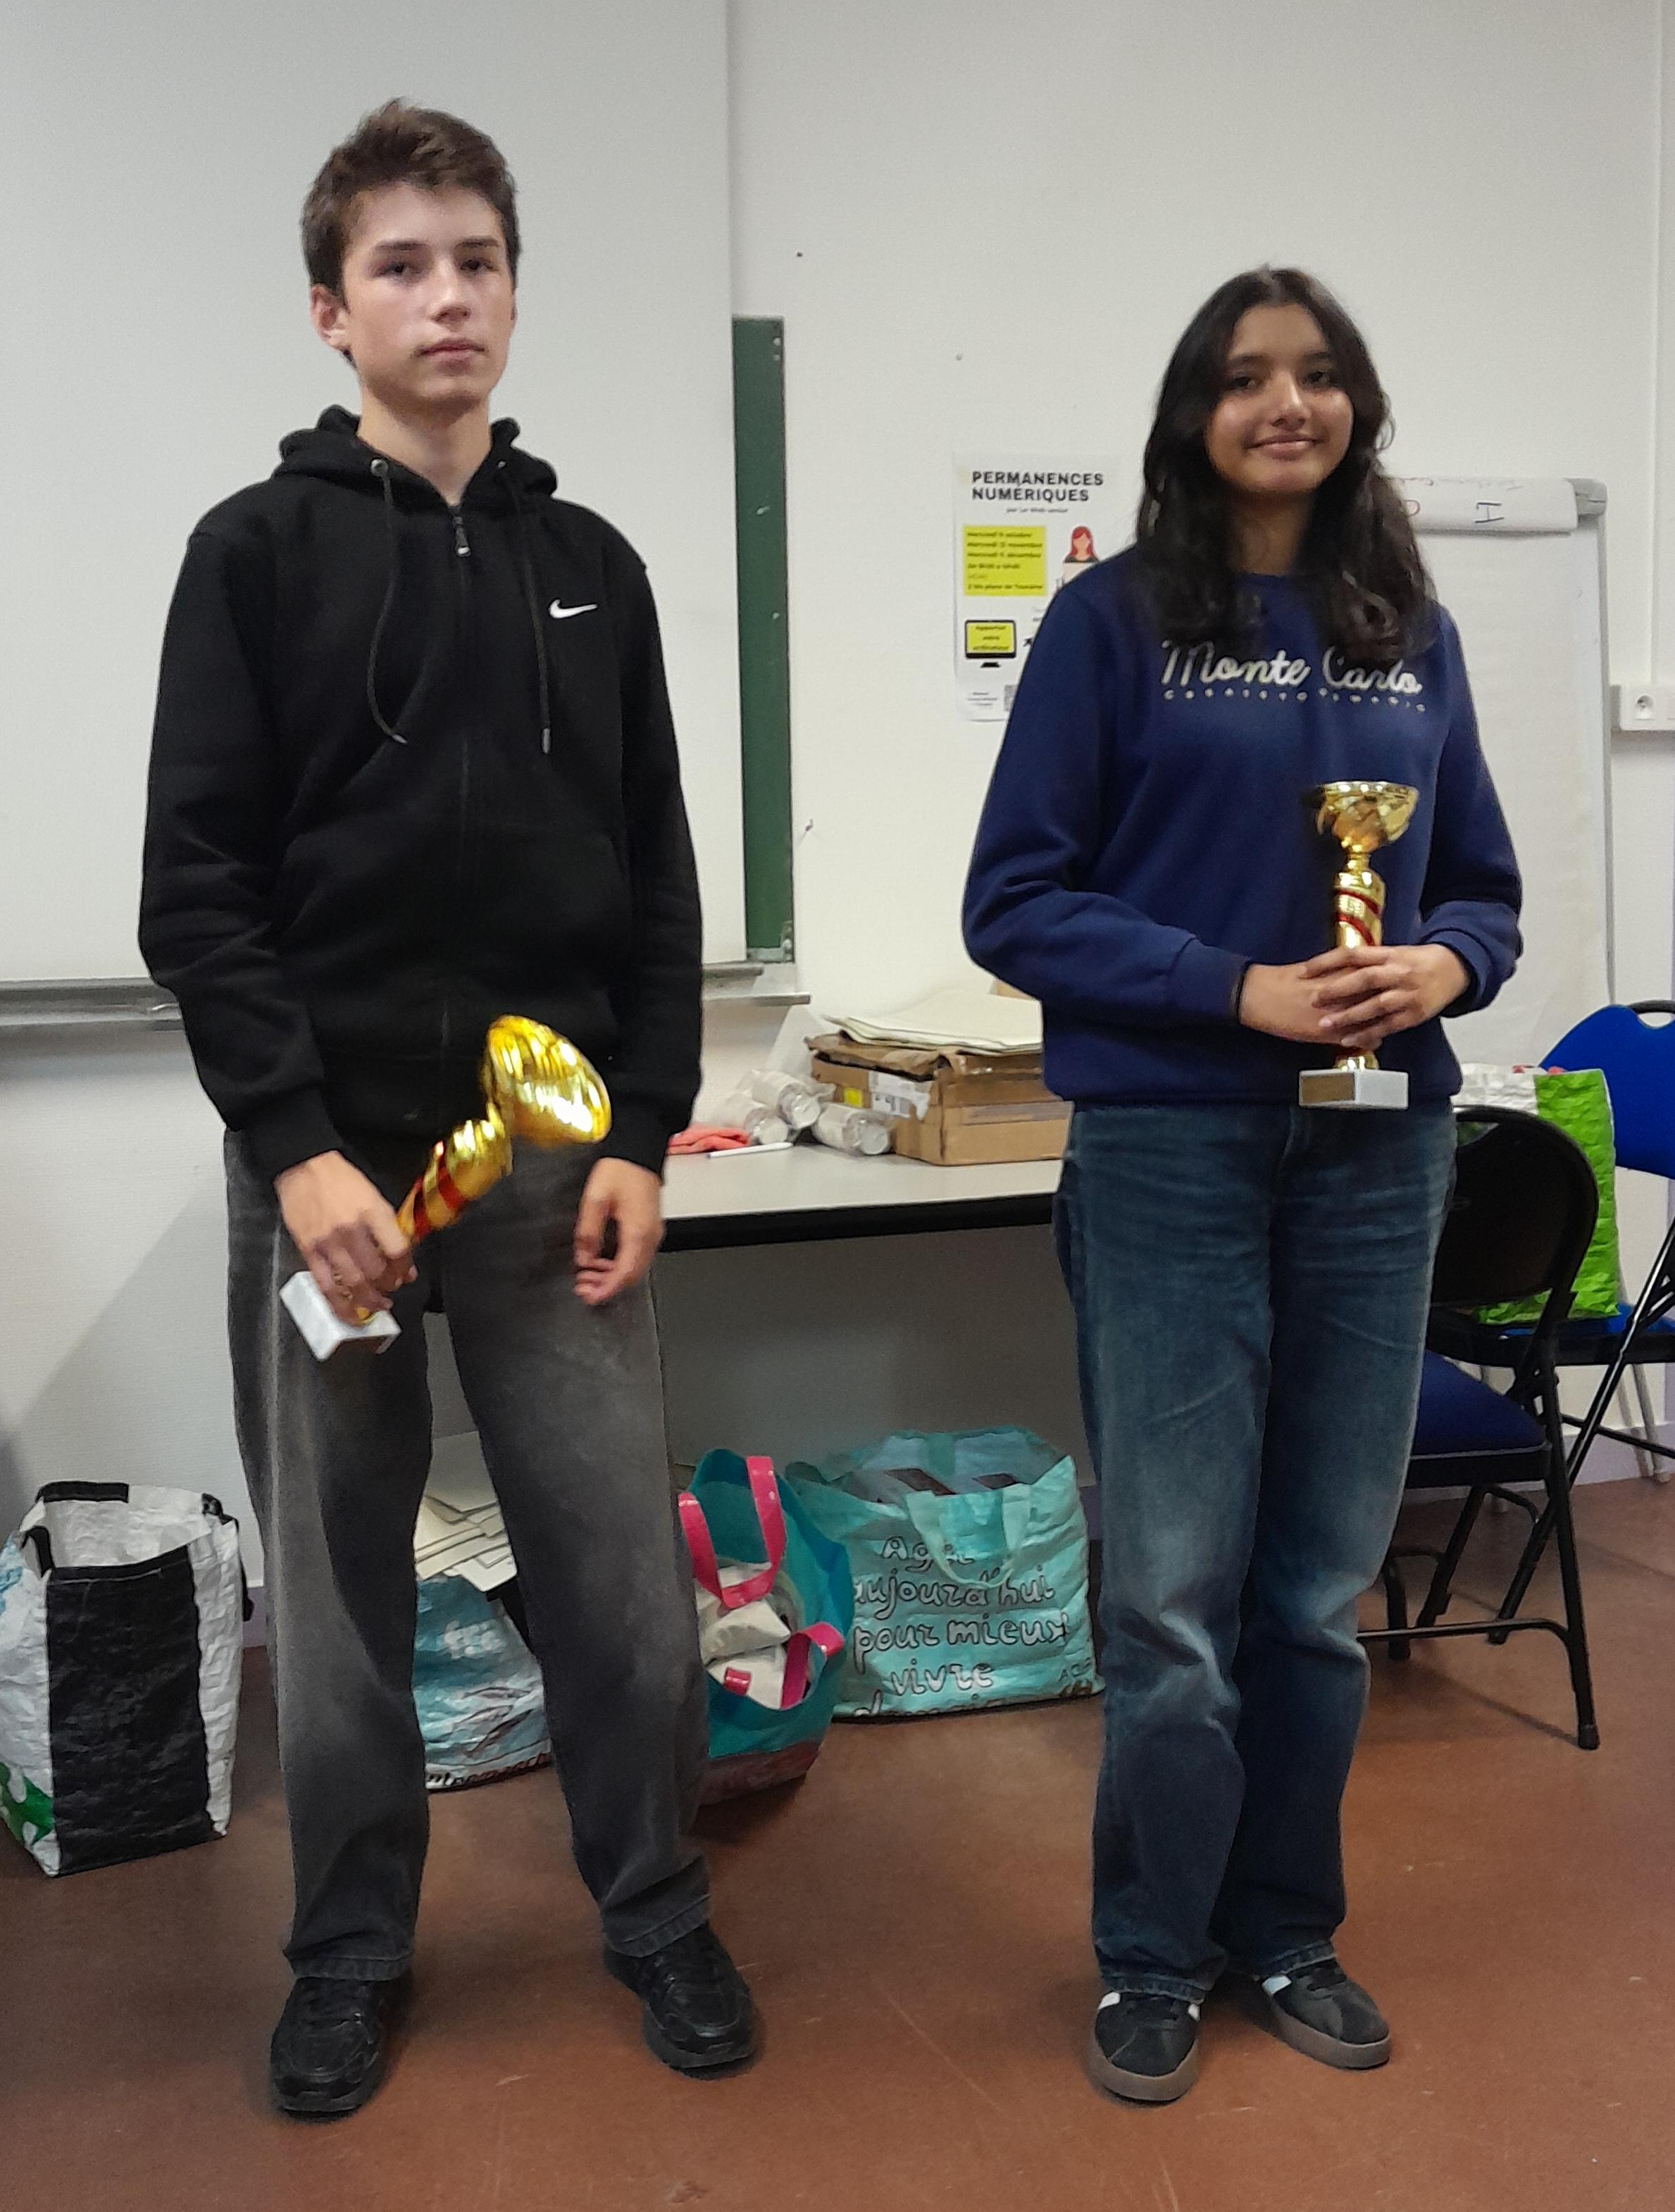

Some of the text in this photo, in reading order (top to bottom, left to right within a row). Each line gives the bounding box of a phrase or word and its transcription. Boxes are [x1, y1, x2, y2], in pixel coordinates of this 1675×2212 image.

[971, 471, 1104, 486] PERMANENCES
[971, 486, 1090, 503] NUMÉRIQUES
[1161, 639, 1424, 695] Monte Carlo
[882, 1536, 975, 1573] Ag
[854, 1612, 1069, 1675] pour mieux
[890, 1658, 995, 1696] vivre
